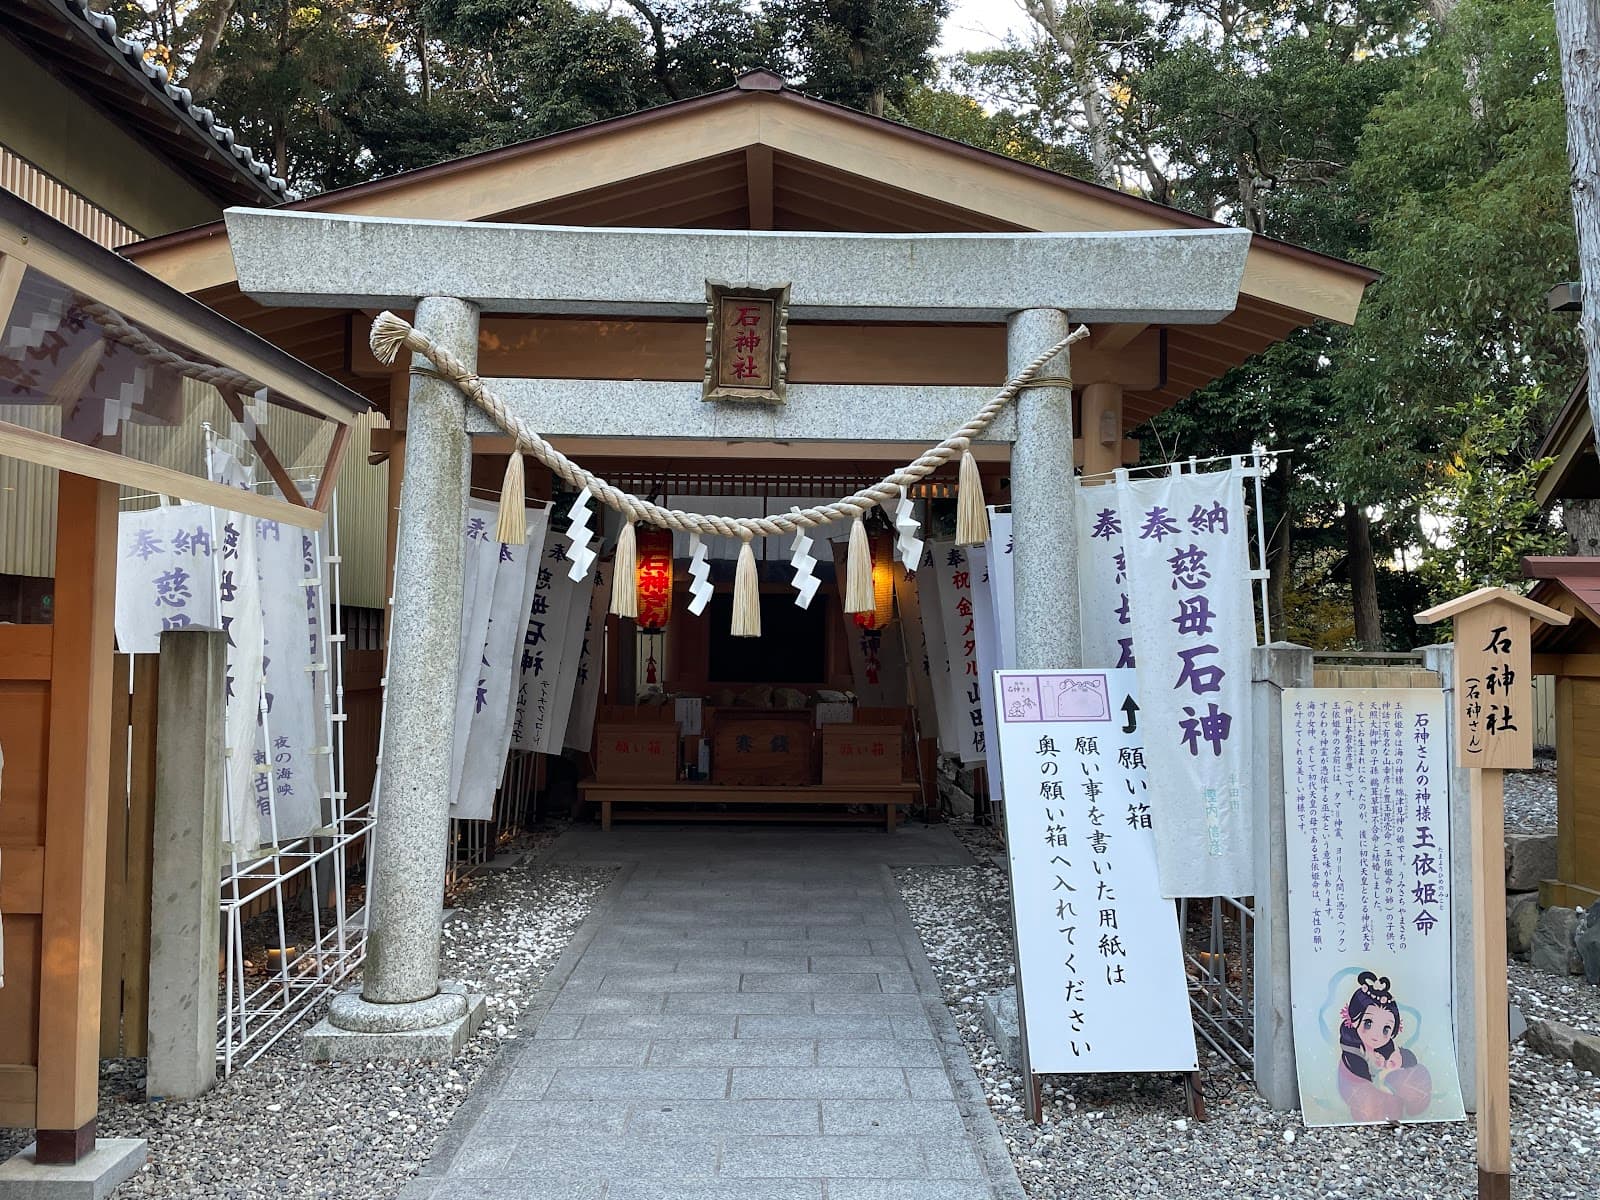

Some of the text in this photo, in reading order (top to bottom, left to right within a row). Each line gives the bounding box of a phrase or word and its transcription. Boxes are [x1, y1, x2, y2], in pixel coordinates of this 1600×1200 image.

[731, 306, 760, 379] 石神社
[126, 525, 211, 561] 奉納
[947, 549, 966, 569] 奉
[1139, 501, 1229, 543] 奉納
[1167, 543, 1232, 757] 慈母石神
[1482, 626, 1518, 736] 石神社
[1465, 678, 1482, 754] (石神さん)
[273, 736, 294, 796] 夜の海峡
[1118, 747, 1152, 830] 願い箱
[1036, 734, 1091, 1057] 奥の願い箱へ入れてください
[1074, 736, 1126, 985] 願い事を書いた用紙は
